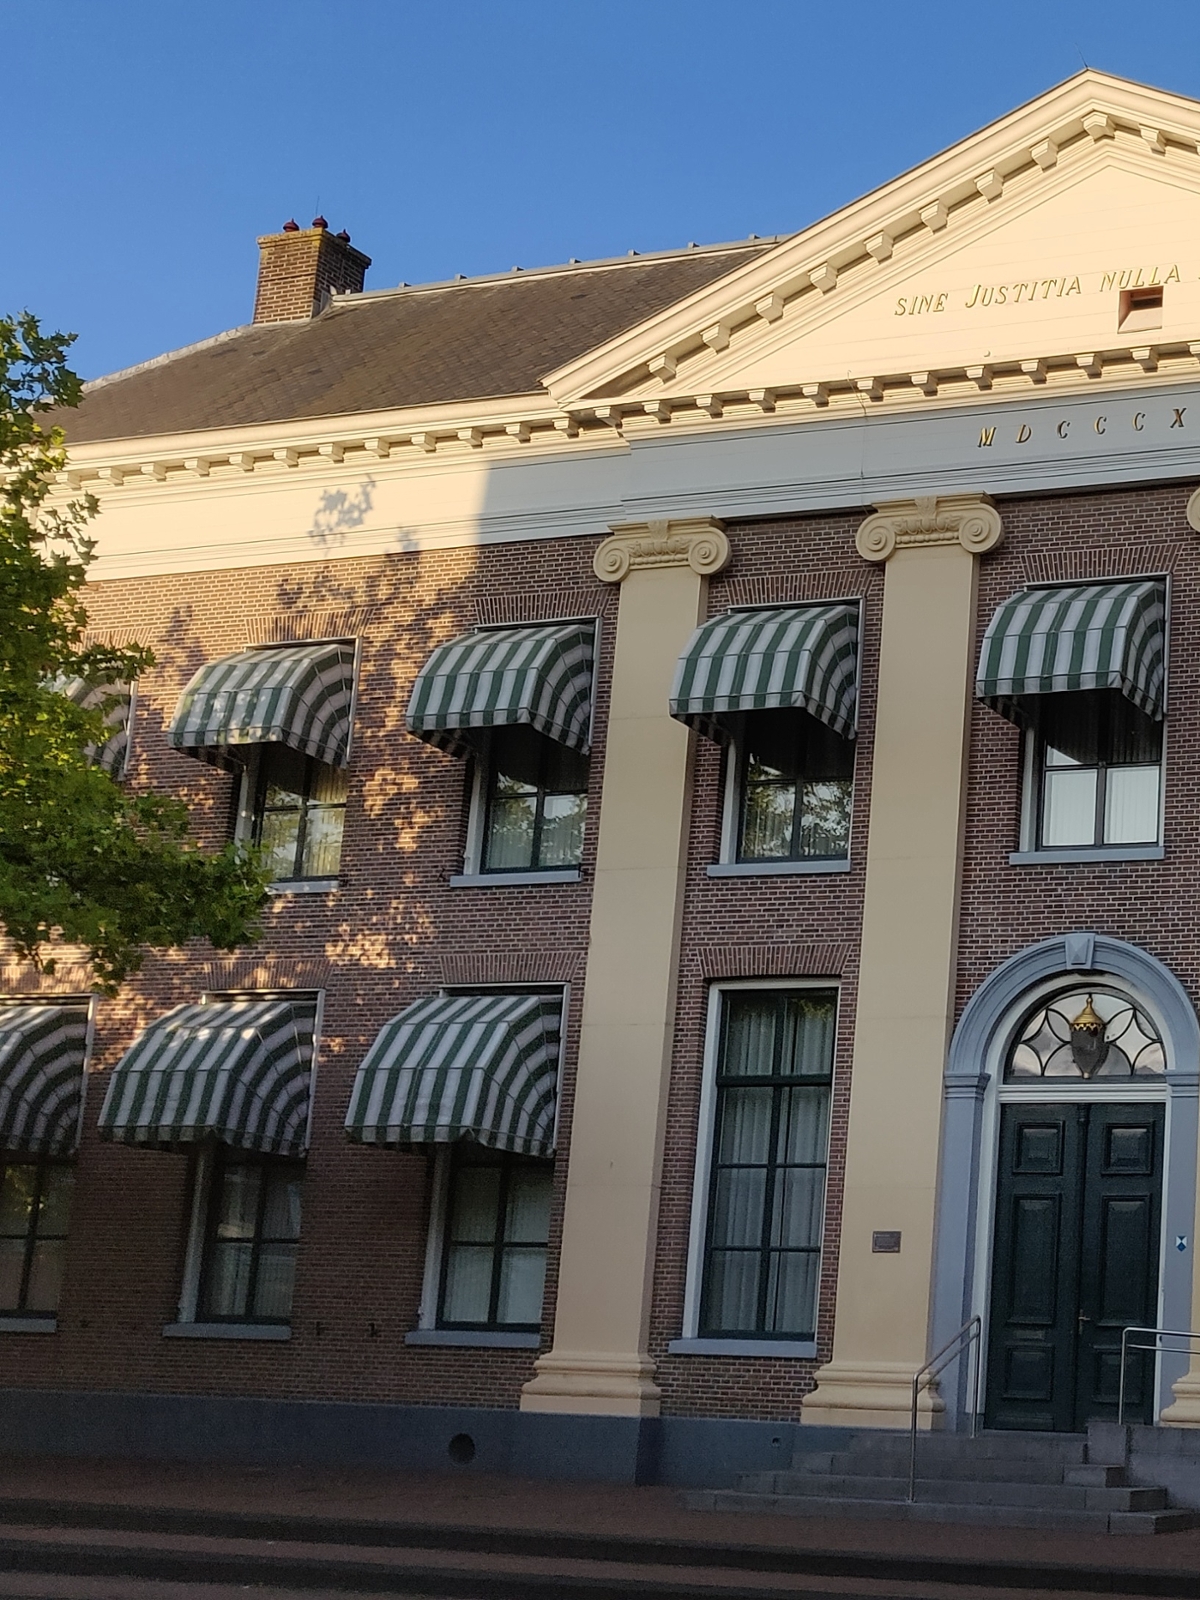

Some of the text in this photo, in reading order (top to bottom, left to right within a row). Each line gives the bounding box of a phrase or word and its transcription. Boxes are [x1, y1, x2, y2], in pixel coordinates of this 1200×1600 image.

[894, 293, 949, 316] SINE
[965, 276, 1082, 309] JUSTITIA
[1099, 264, 1182, 293] NULLA
